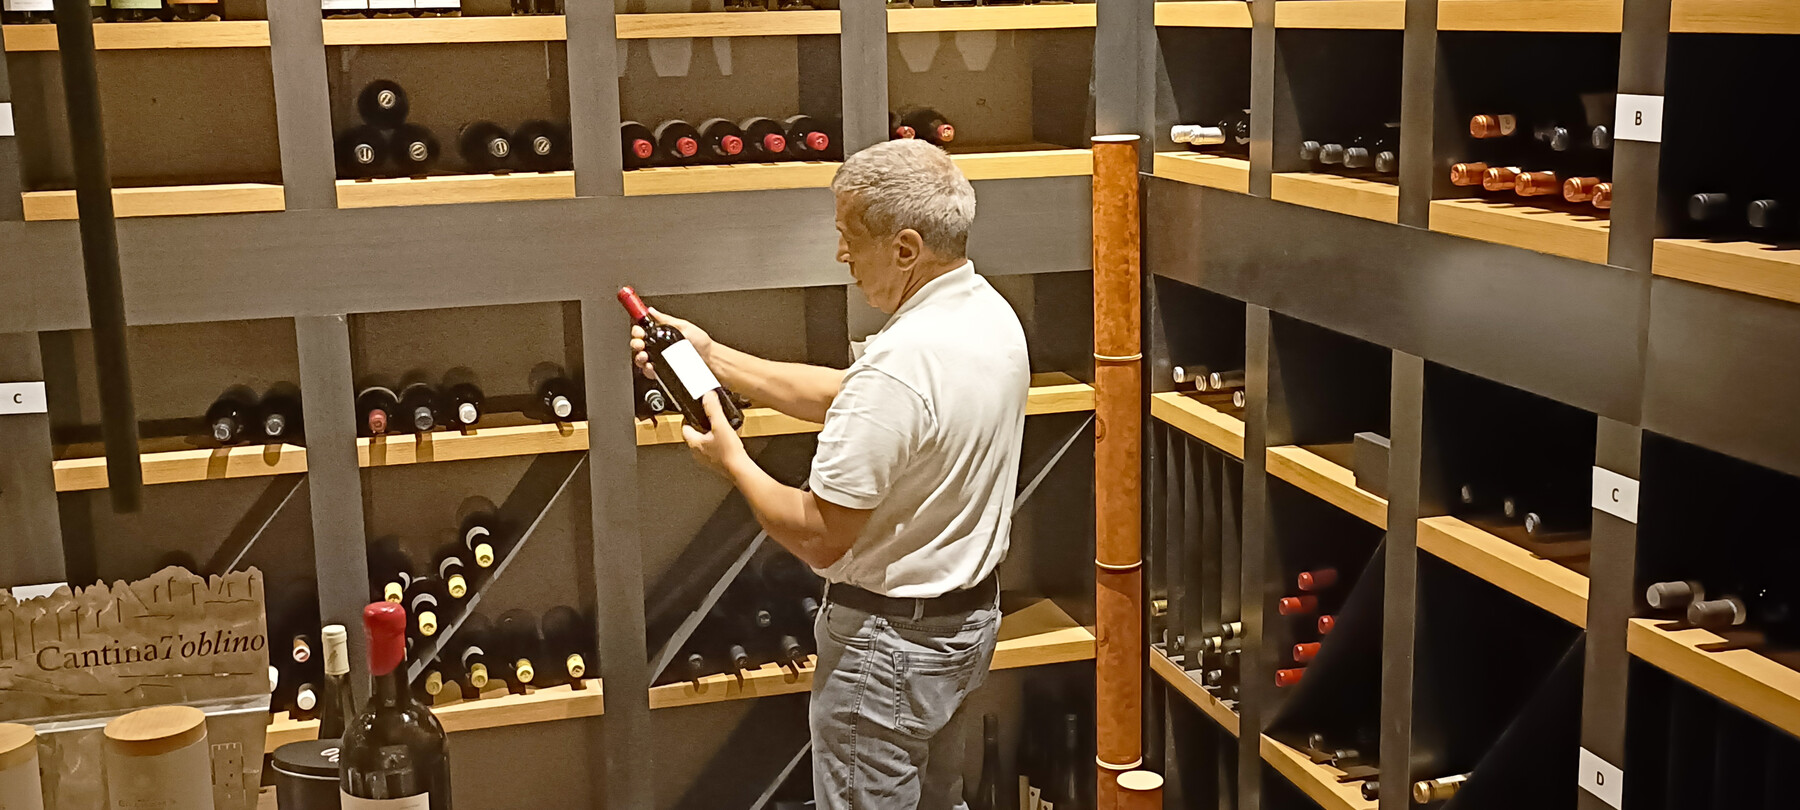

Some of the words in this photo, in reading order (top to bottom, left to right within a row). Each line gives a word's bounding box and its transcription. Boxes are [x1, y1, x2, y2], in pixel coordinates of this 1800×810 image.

[1634, 110, 1643, 126] B
[13, 392, 23, 404] C
[1611, 487, 1620, 503] C
[36, 639, 159, 672] Cantina
[1596, 770, 1605, 786] D
